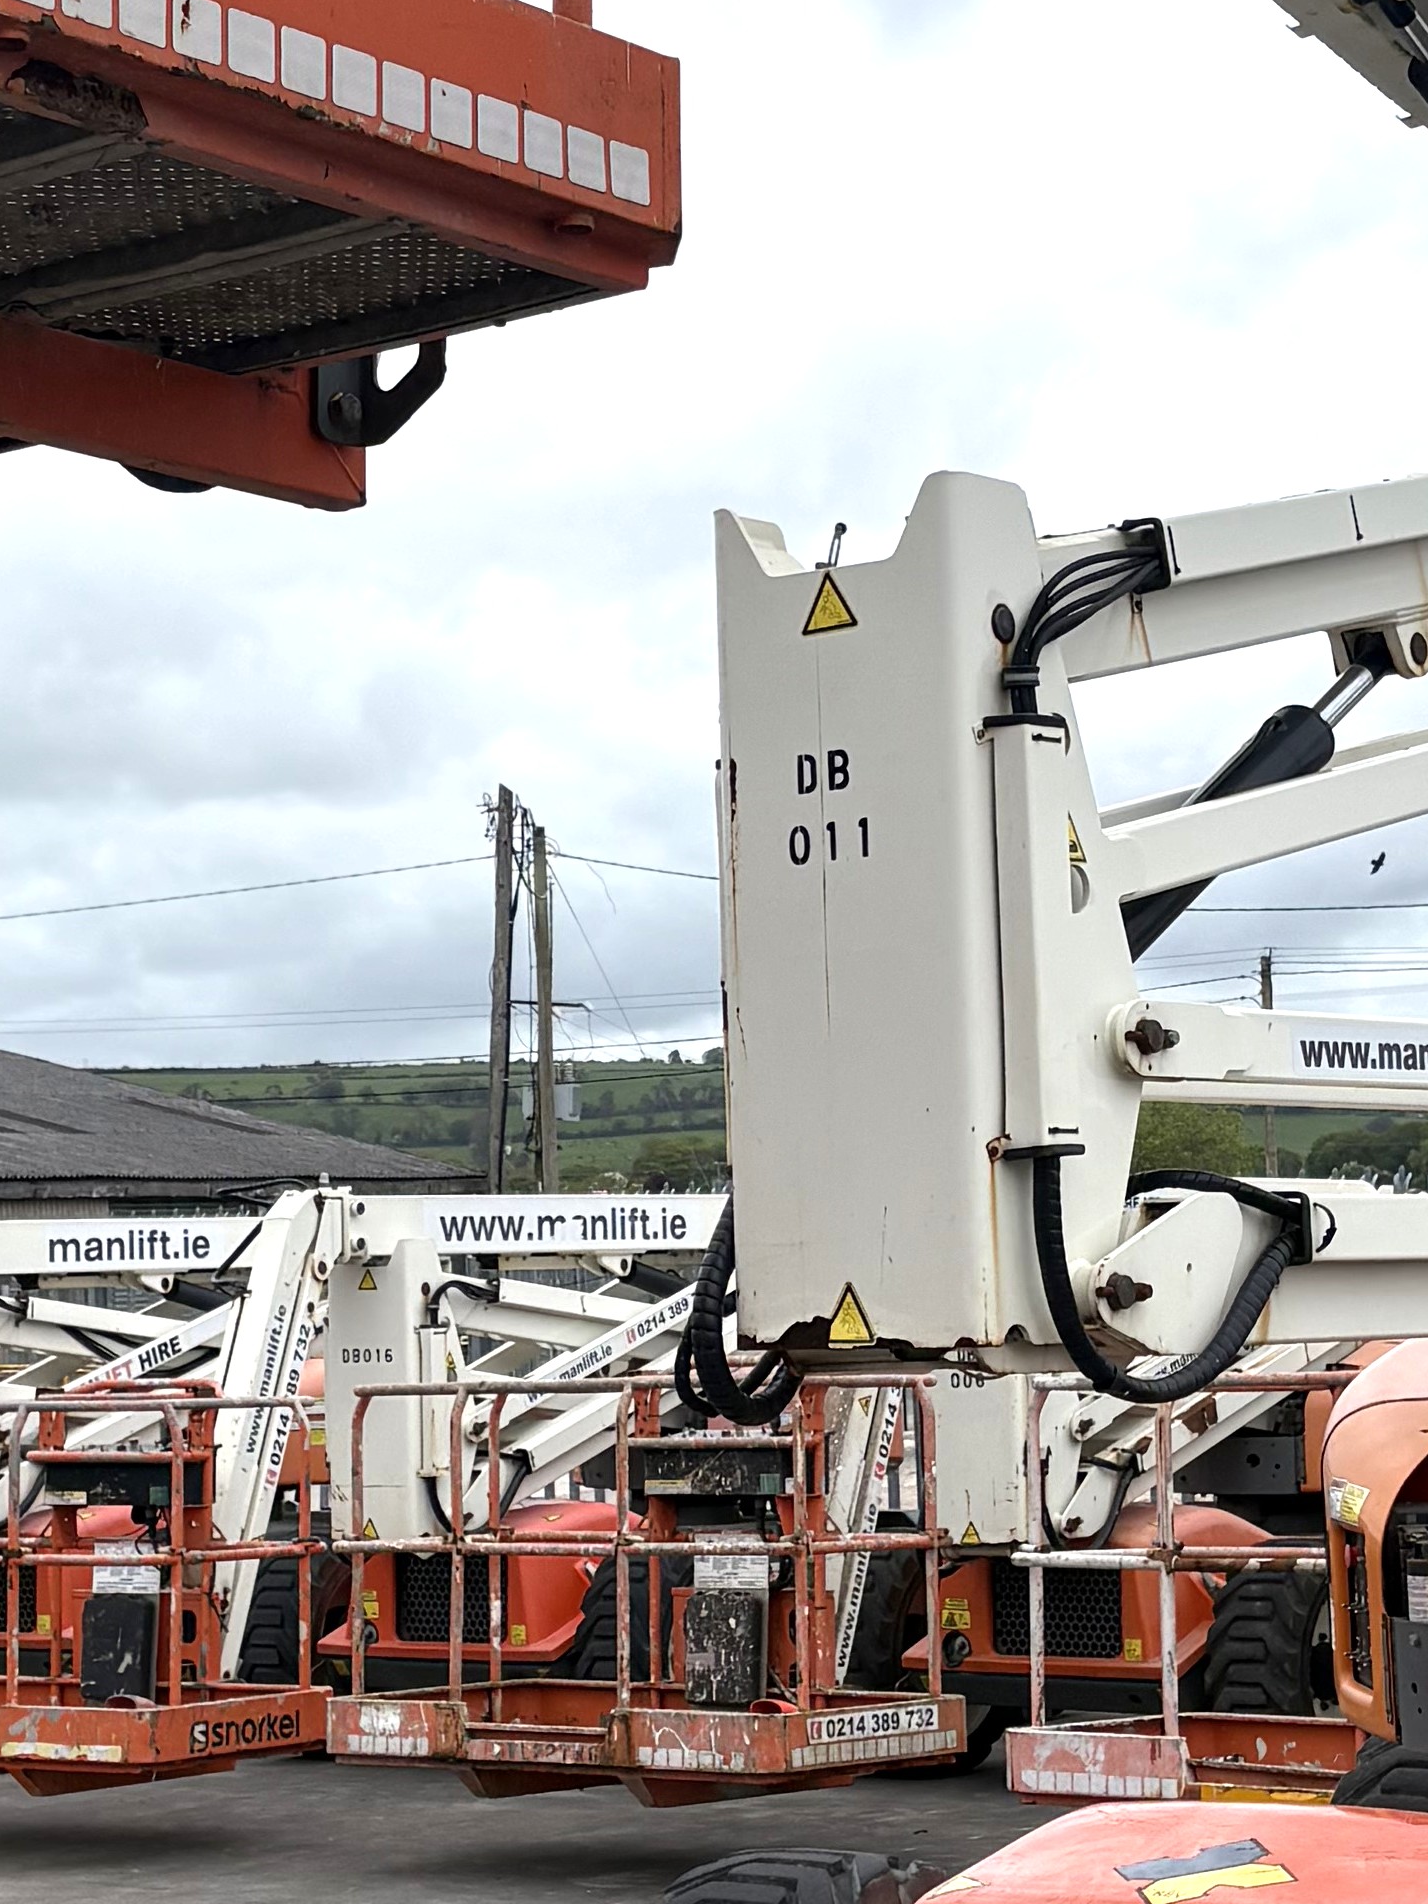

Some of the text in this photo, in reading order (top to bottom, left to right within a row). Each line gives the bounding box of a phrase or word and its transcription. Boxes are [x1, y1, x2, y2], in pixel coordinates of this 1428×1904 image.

[796, 748, 850, 795] DB
[789, 817, 870, 866] 011
[48, 1228, 211, 1263] manlift.ie
[637, 1311, 667, 1338] 0214
[667, 1297, 689, 1320] 389
[137, 1335, 182, 1372] HIRE
[342, 1348, 393, 1363] DB016
[270, 1323, 311, 1466] 0214 89 732
[879, 1402, 897, 1459] 0214
[212, 1708, 300, 1748] snorkel
[826, 1707, 934, 1739] 0214 389 732
